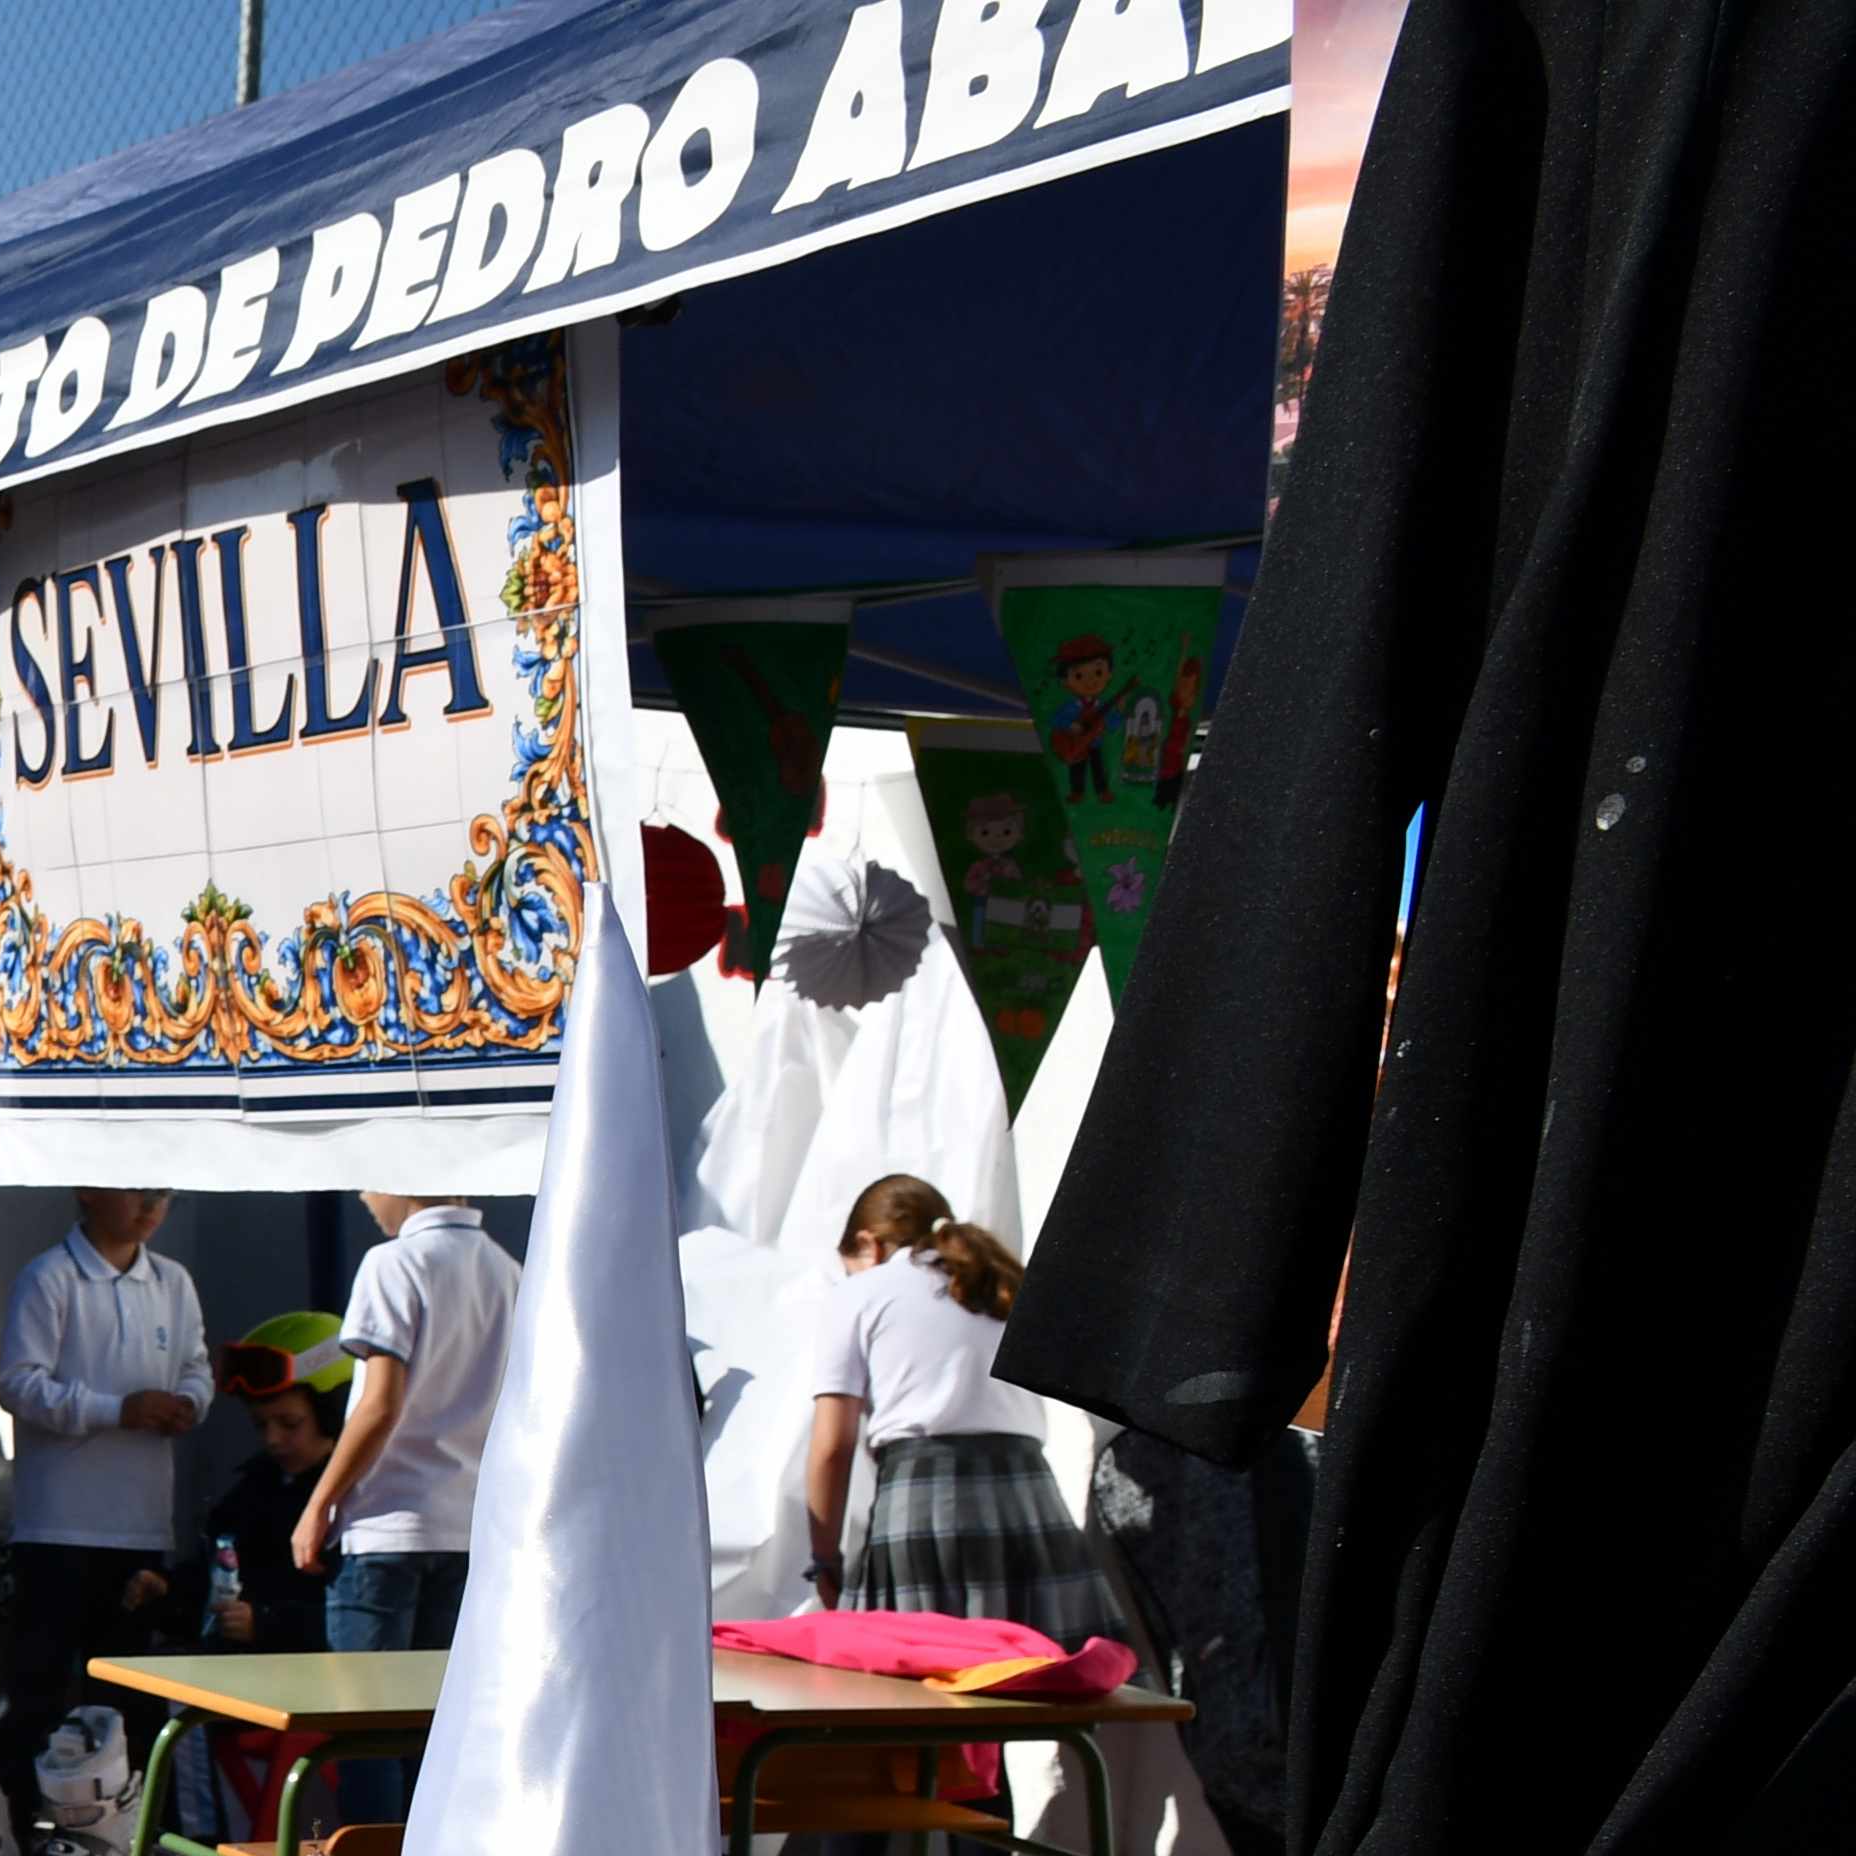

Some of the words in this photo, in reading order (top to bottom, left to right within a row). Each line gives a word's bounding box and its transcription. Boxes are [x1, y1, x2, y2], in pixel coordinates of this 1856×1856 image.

[104, 247, 279, 431] DE
[270, 58, 758, 376] PEDRO
[11, 477, 492, 791] SEVILLA
